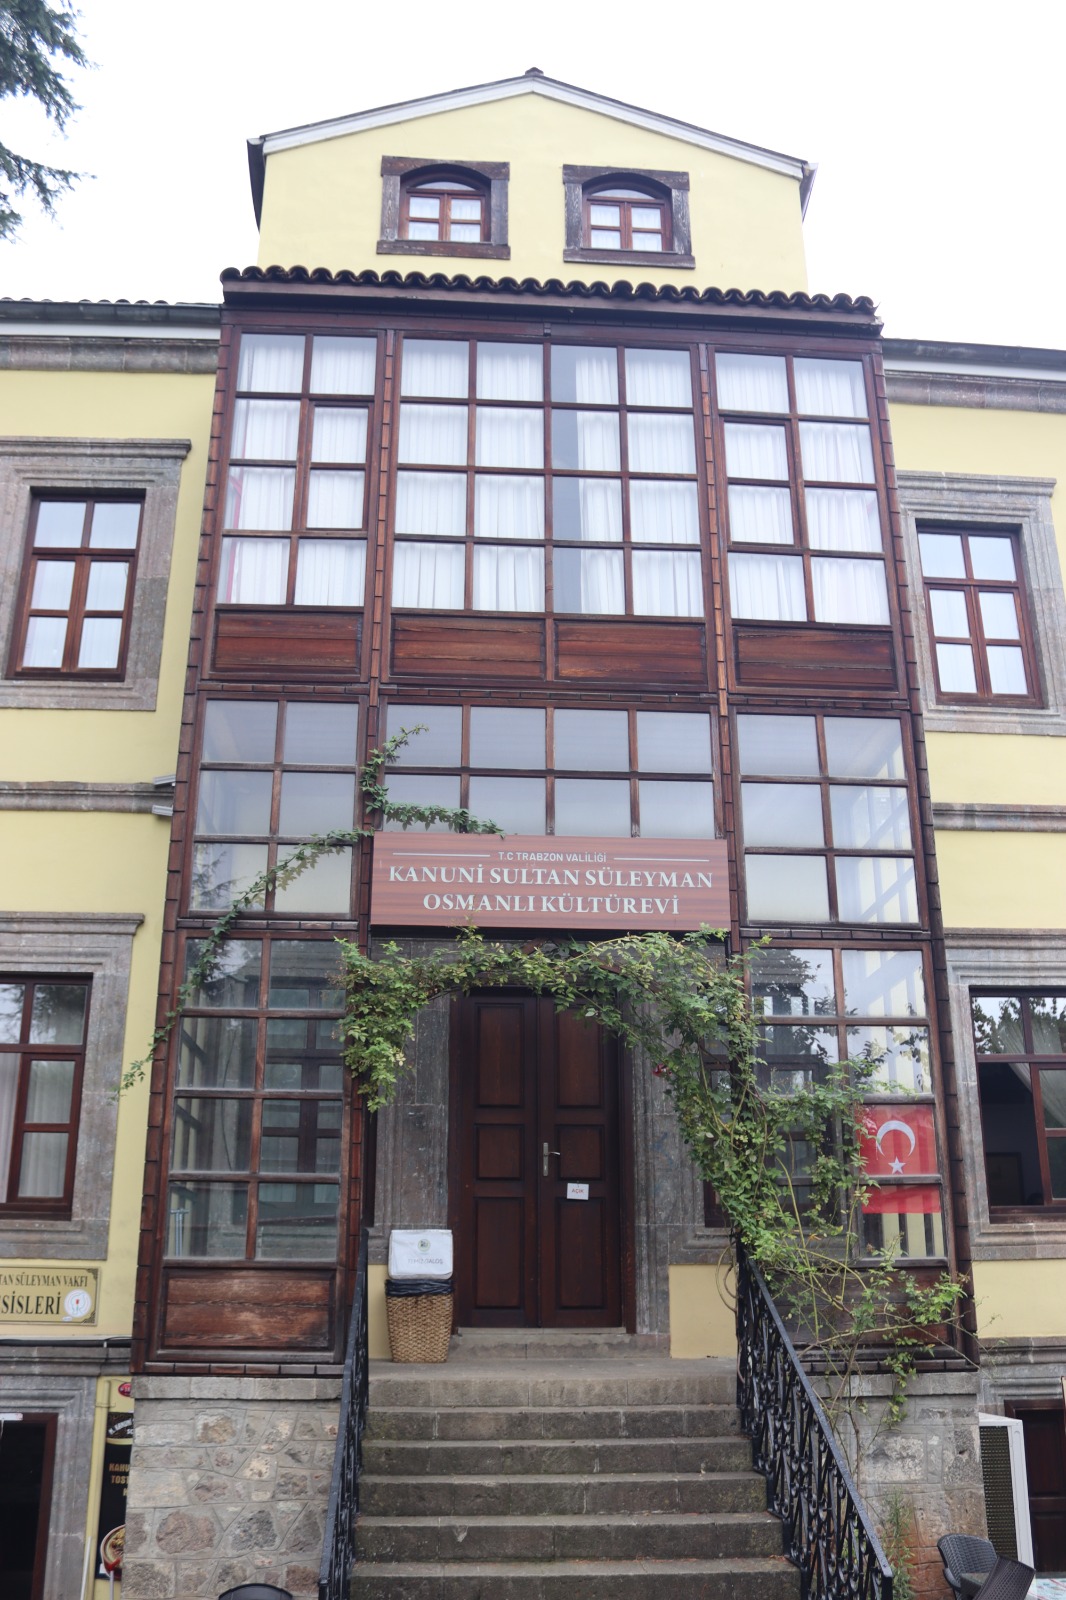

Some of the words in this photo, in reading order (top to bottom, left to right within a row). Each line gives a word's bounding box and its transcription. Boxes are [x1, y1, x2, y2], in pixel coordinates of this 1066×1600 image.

[516, 851, 564, 862] TRABZON
[389, 863, 484, 884] KANUNİ
[490, 867, 580, 886] SULTAN
[585, 867, 713, 889] SÜLEYMAN
[423, 892, 543, 912] OSMANLI
[540, 893, 680, 915] KÜLTÜREVİ
[64, 1275, 88, 1288] VAKFI
[0, 1290, 62, 1315] SİSLERİ
